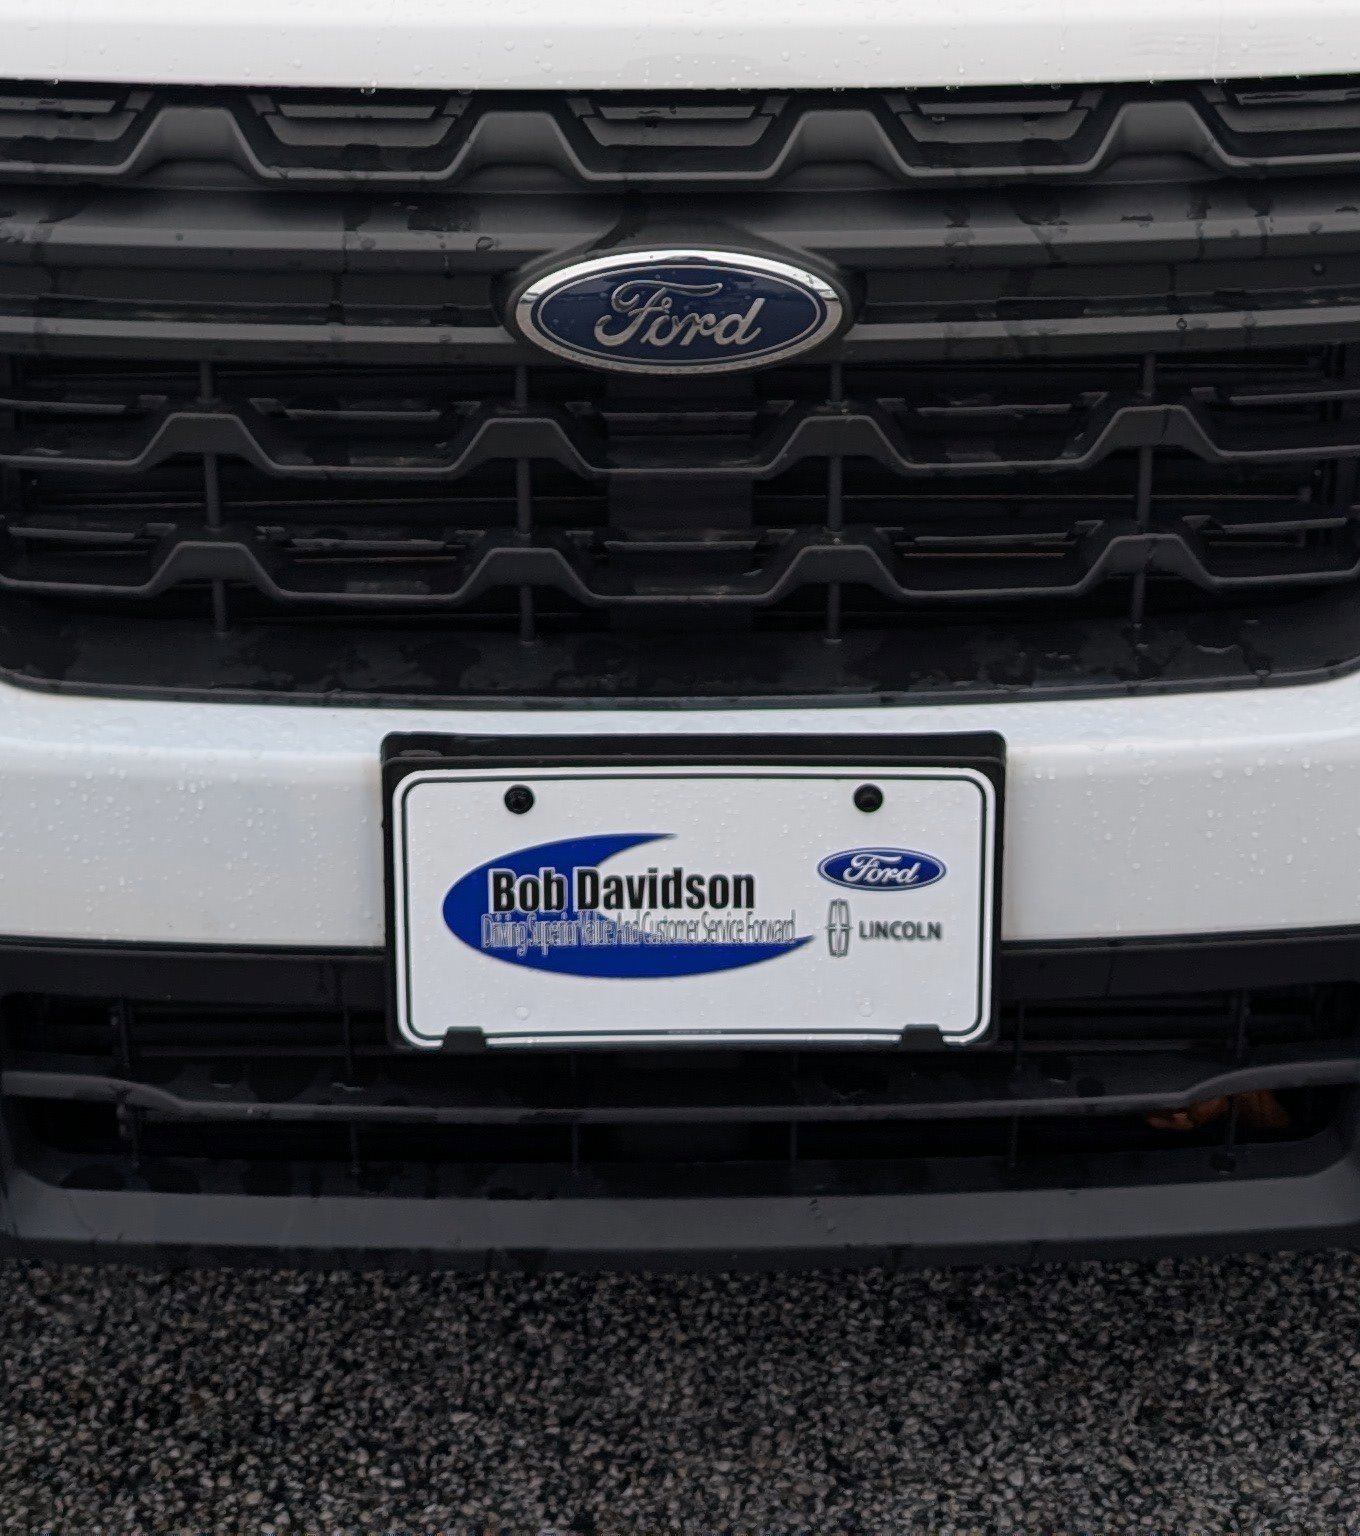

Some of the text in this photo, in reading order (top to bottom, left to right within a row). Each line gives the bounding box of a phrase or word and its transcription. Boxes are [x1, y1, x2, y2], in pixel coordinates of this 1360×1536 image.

[593, 278, 767, 348] Ford
[489, 866, 756, 912] Bob Davidson
[842, 853, 921, 884] Ford
[481, 913, 527, 956] Driving
[641, 911, 699, 944] Customer
[700, 910, 744, 944] Service
[745, 909, 797, 944] Forward
[858, 920, 943, 941] LINCOLN
